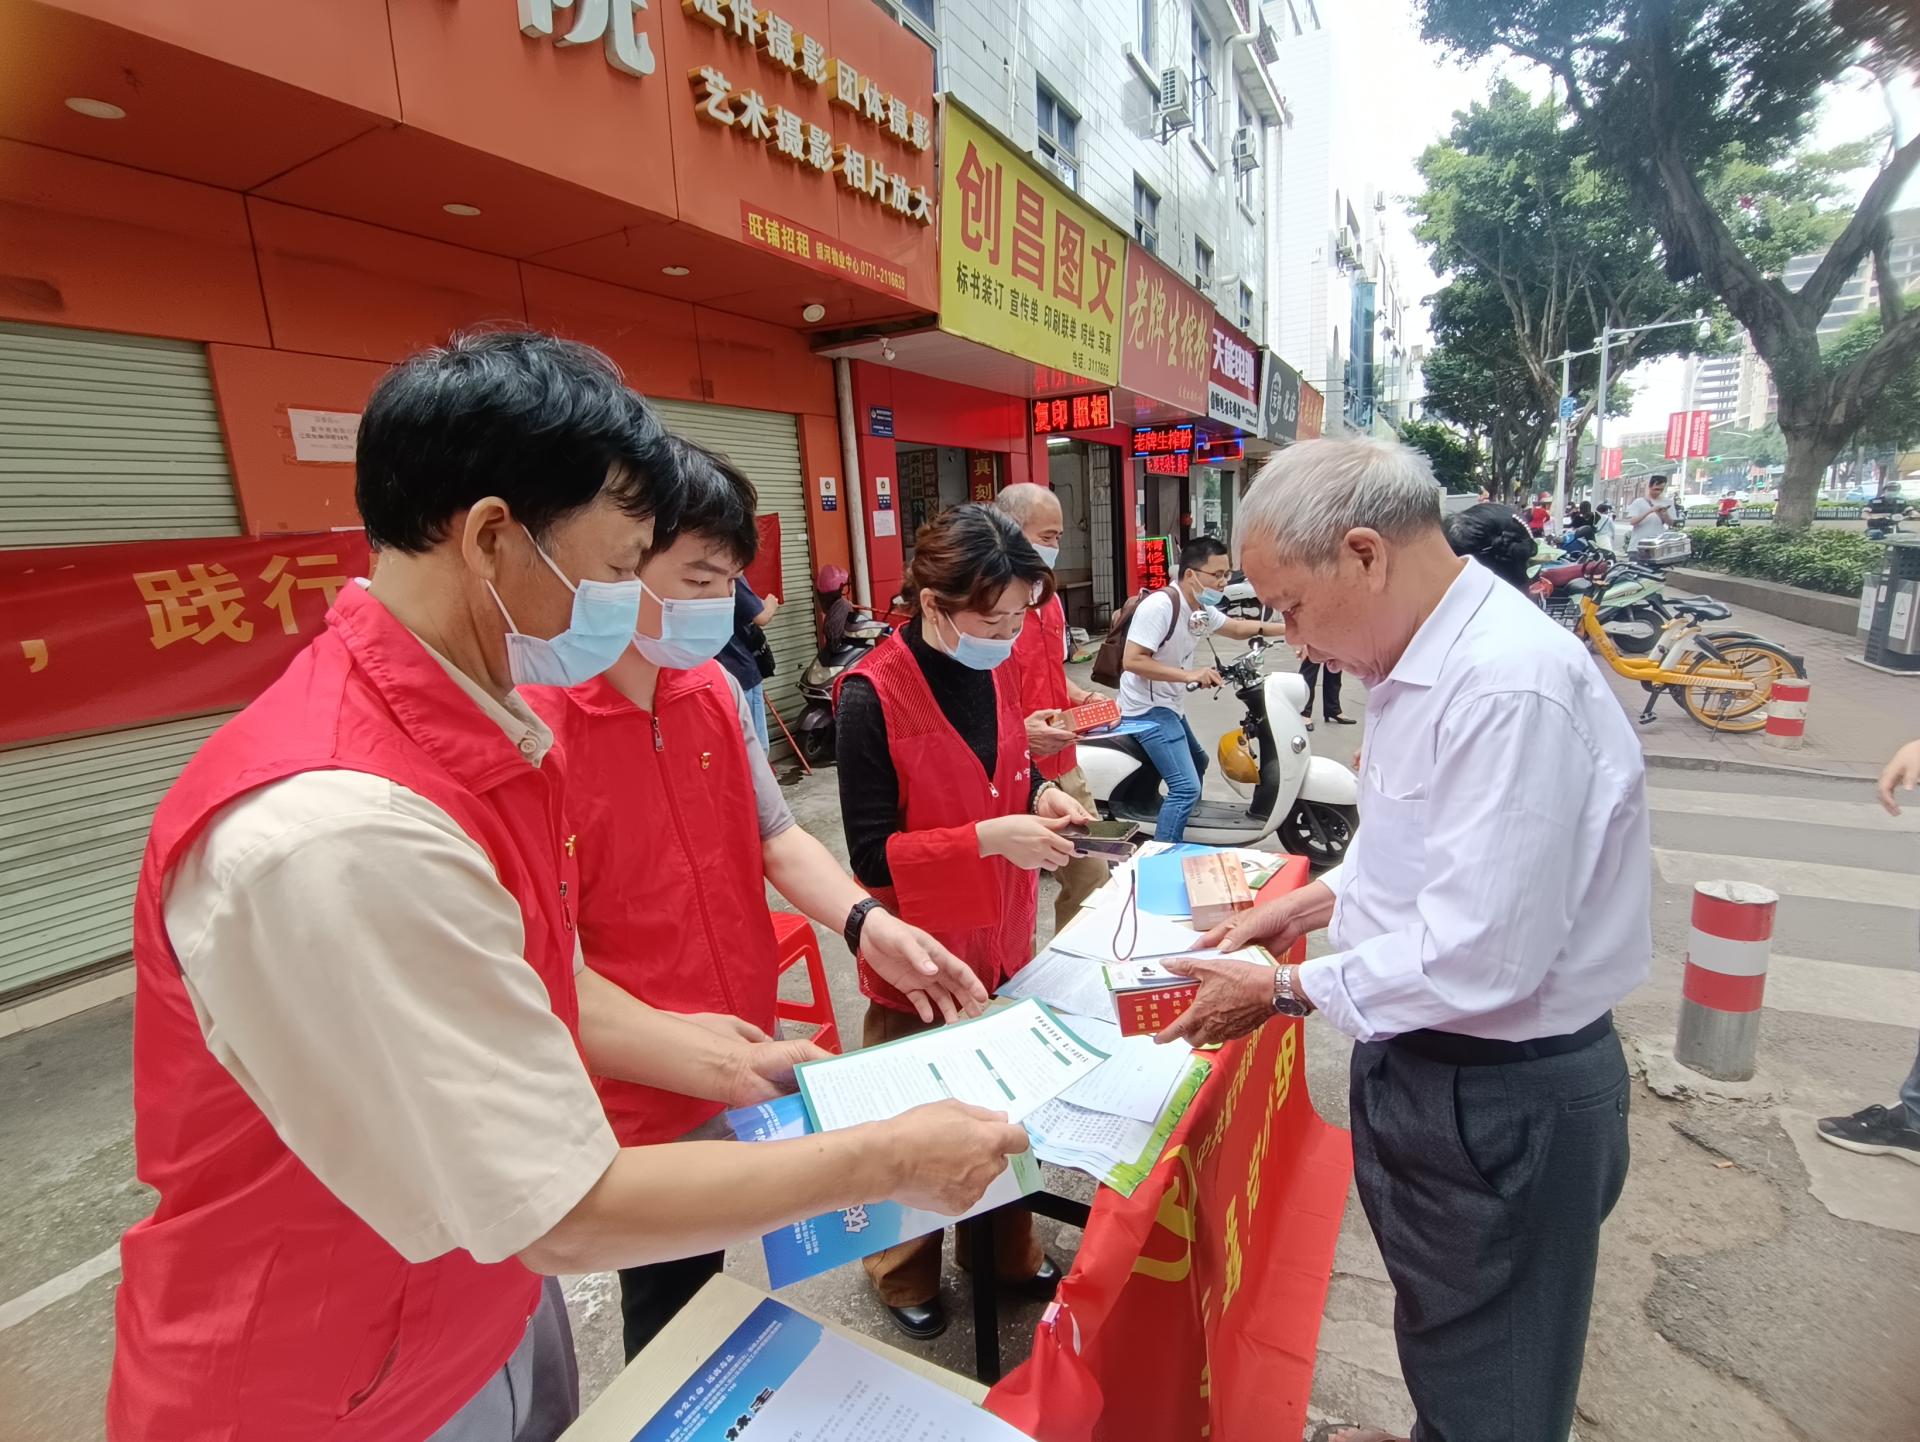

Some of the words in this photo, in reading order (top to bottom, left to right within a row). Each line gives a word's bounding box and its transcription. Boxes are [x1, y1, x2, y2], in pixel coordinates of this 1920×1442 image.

[833, 57, 931, 152] 团体摄影
[700, 65, 835, 174] 艺术摄影
[839, 144, 934, 226] 相片放大
[748, 212, 811, 259] 旺铺招租
[955, 138, 1117, 324] 创昌图文
[956, 260, 1005, 310] 标书装订
[1009, 287, 1039, 326] 宣传单
[1043, 304, 1077, 342] 印刷联单
[1080, 322, 1096, 351] 喷绘
[1098, 329, 1112, 357] 写真
[1128, 264, 1209, 384] 老牌生榨粉
[1213, 327, 1255, 391] 天能电池
[1034, 399, 1068, 433] 复印
[1072, 394, 1109, 428] 照相
[1134, 428, 1193, 452] 老牌生榨粉
[972, 450, 994, 500] 真刻
